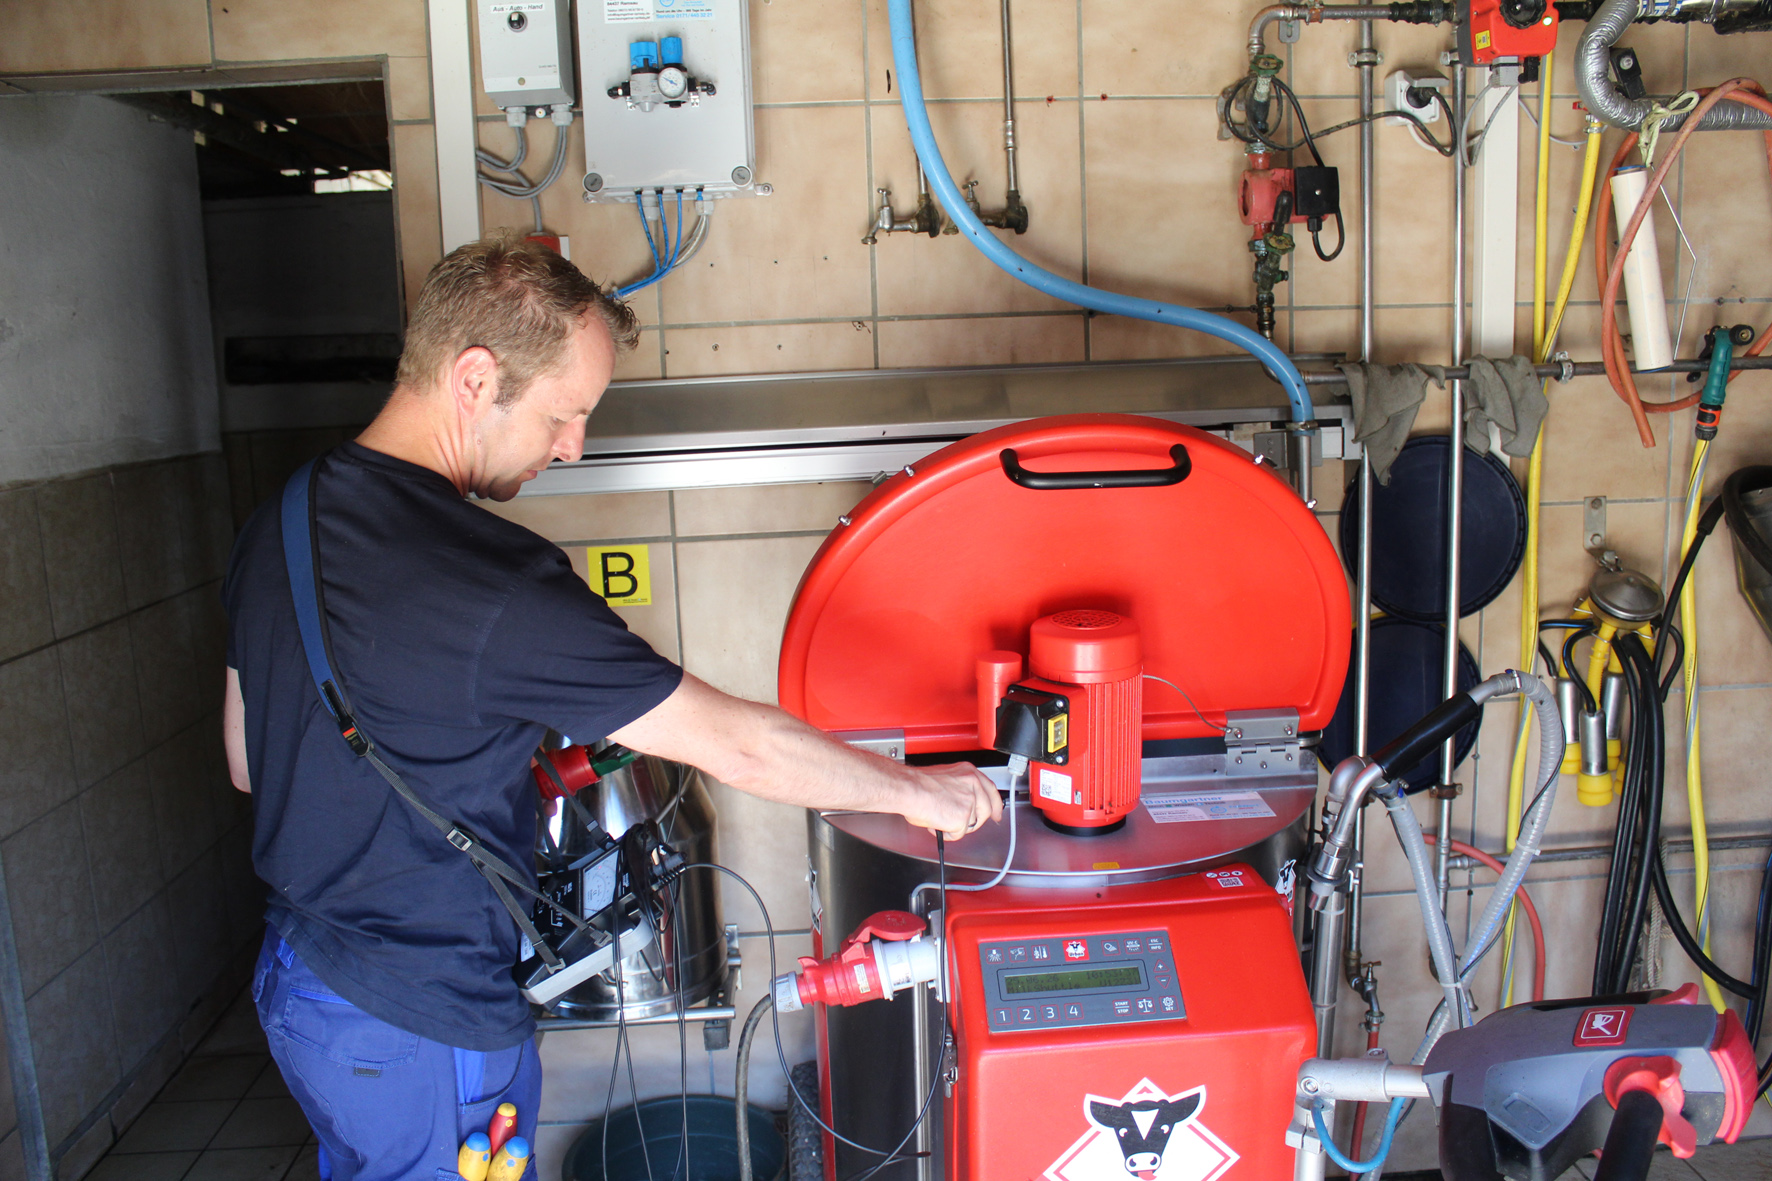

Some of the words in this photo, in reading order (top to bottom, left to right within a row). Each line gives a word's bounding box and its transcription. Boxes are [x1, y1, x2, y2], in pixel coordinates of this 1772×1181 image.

[601, 552, 638, 598] B
[1146, 796, 1222, 804] Baumgartner
[1000, 1011, 1006, 1021] 1
[1022, 1009, 1031, 1020] 2
[1047, 1007, 1055, 1018] 3
[1069, 1006, 1078, 1016] 4
